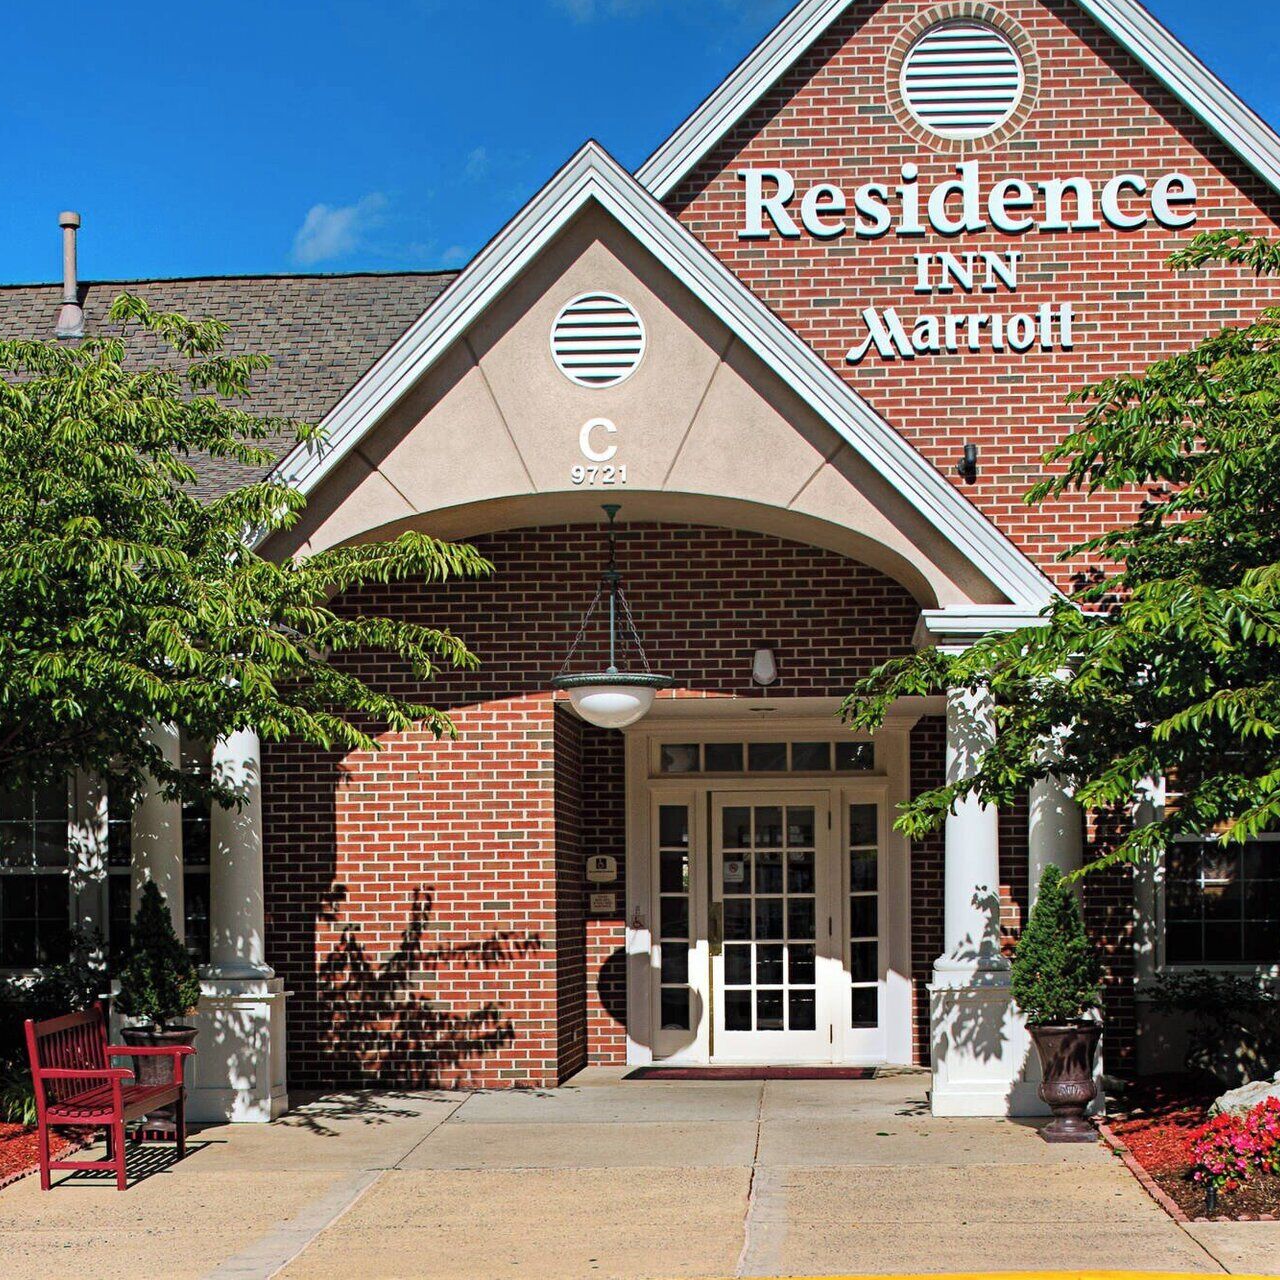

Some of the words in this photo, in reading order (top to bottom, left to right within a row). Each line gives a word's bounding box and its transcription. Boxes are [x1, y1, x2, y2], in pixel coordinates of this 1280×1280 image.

[738, 160, 1198, 239] Residence
[913, 251, 1022, 295] INN
[845, 302, 1075, 364] Marriott
[579, 417, 618, 462] C
[571, 464, 628, 485] 9721
